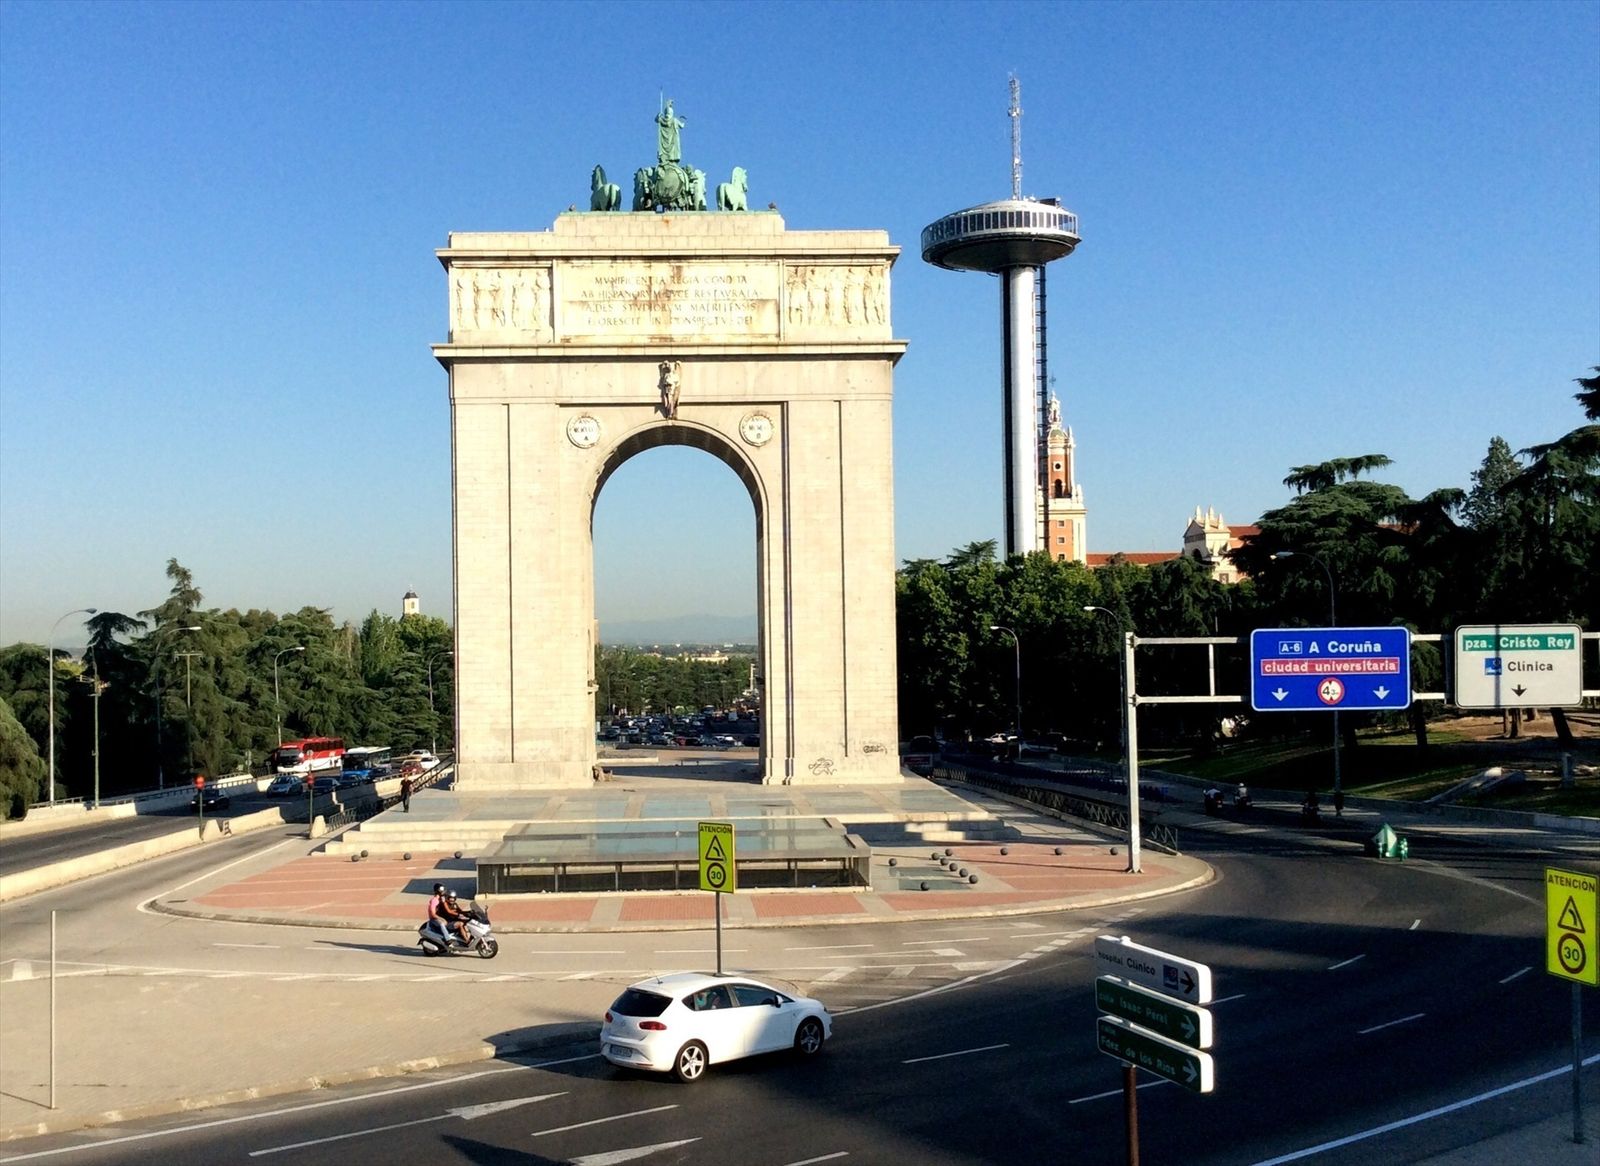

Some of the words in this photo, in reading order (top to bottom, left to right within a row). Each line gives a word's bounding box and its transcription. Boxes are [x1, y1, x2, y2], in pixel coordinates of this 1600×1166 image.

[1281, 643, 1301, 652] A-6
[1309, 641, 1320, 653] A
[1327, 640, 1382, 653] Coruña
[1465, 640, 1493, 650] pza.
[1499, 637, 1540, 648] Cristo
[1547, 637, 1572, 649] Rey
[1264, 661, 1309, 673] ciudad
[1315, 660, 1397, 672] universitaria
[710, 870, 722, 880] 30
[1548, 874, 1595, 892] ATENCIÓN
[1563, 946, 1580, 961] 30
